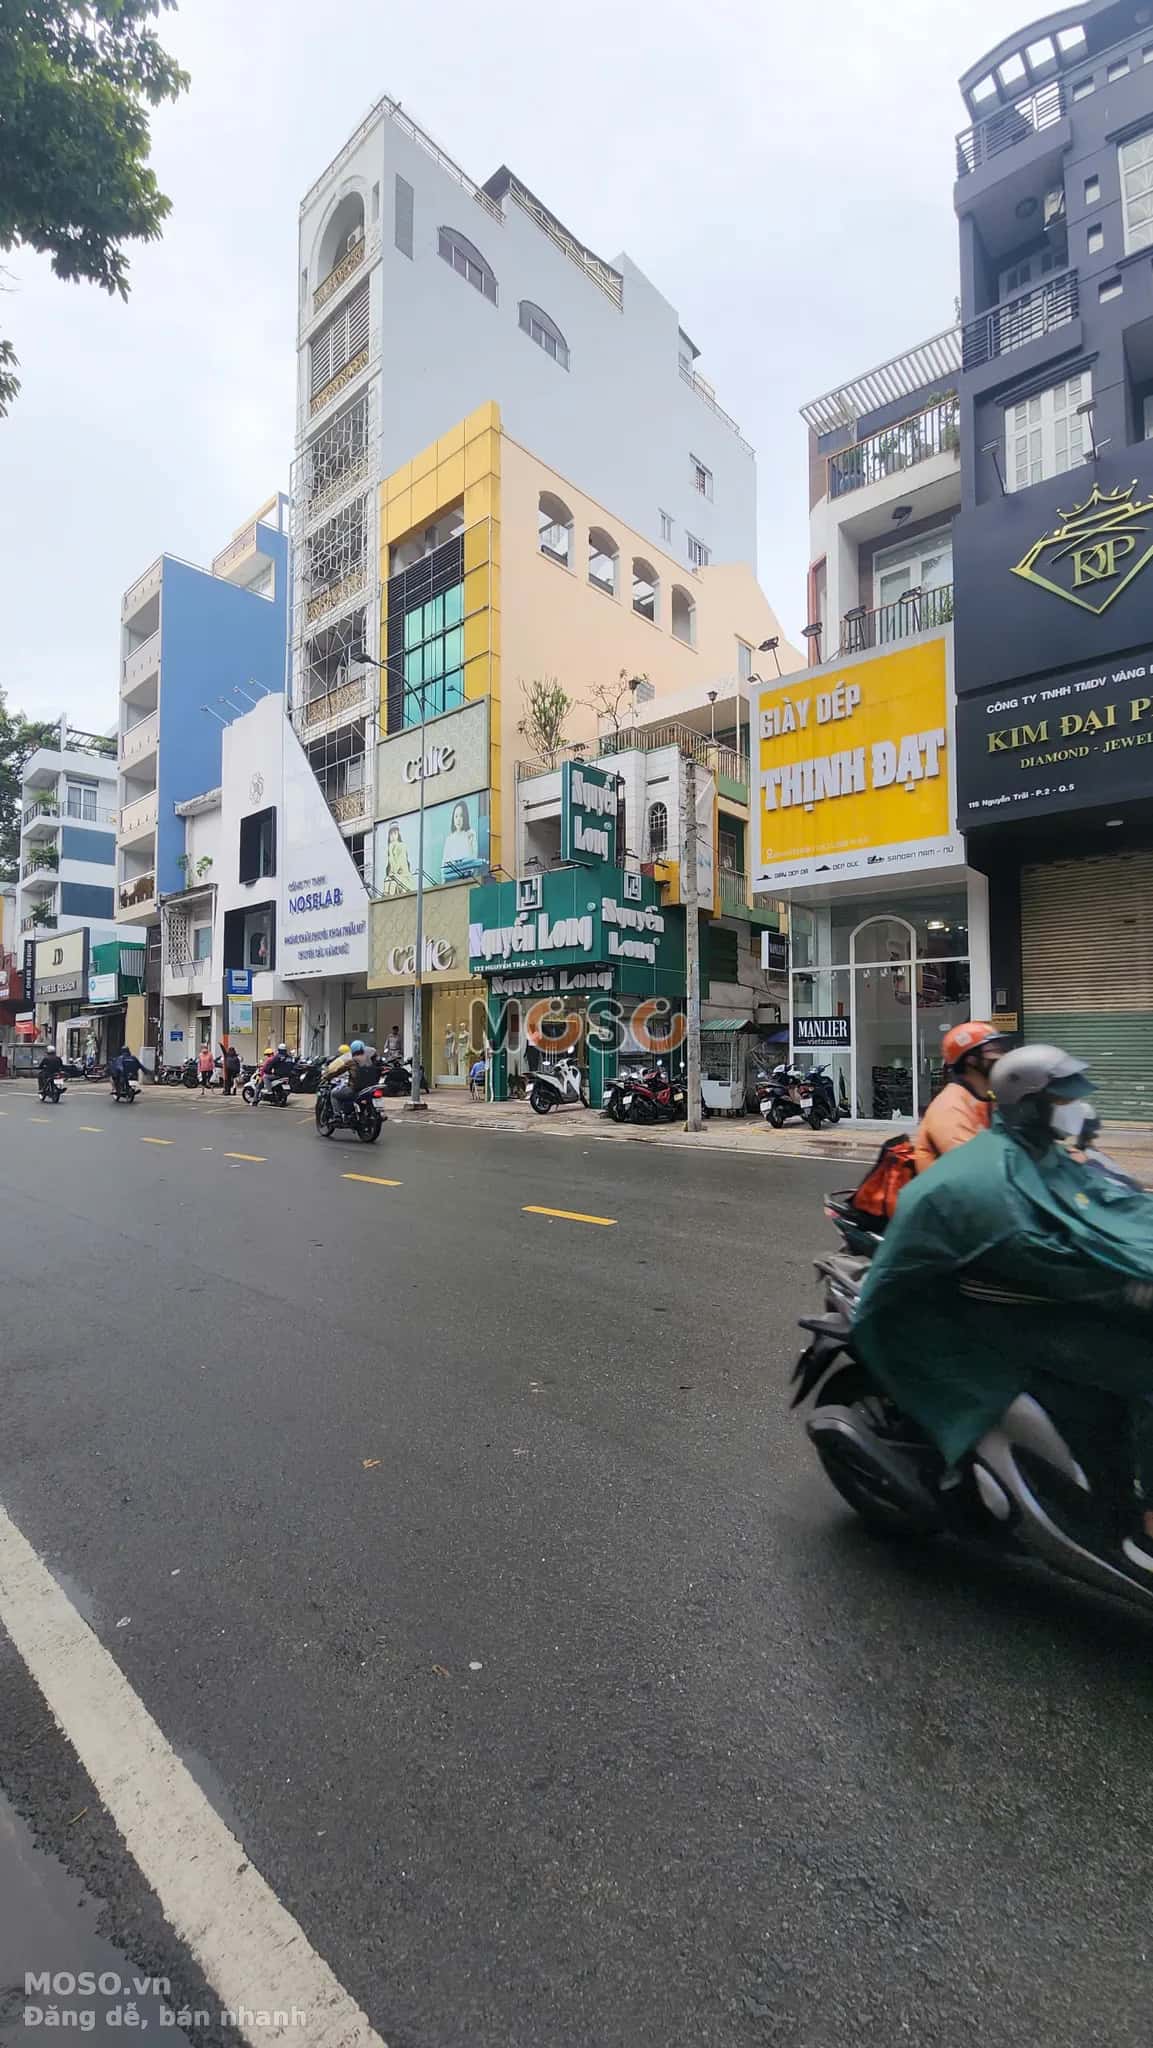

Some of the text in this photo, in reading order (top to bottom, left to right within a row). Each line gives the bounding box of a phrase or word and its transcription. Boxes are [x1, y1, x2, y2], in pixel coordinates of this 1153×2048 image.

[987, 699, 1018, 713] CÔNG
[1022, 694, 1037, 705] TY
[1040, 686, 1071, 701] TNHH
[1074, 677, 1107, 692] TMDV
[1111, 667, 1145, 683] VÀNG
[760, 680, 862, 739] GIÀY DÉP
[987, 696, 1153, 752] KIM ĐẠI P
[760, 728, 945, 812] THỊNH ĐẠT
[1020, 746, 1089, 769] DIAMOND
[1036, 788, 1050, 797] P.2
[1059, 784, 1074, 792] Q.5
[574, 815, 609, 861] Long
[289, 888, 343, 914] NOSELAB
[538, 913, 593, 951] Long
[608, 931, 656, 964] Long
[560, 970, 613, 991] Long
[798, 1019, 848, 1038] MANLIER
